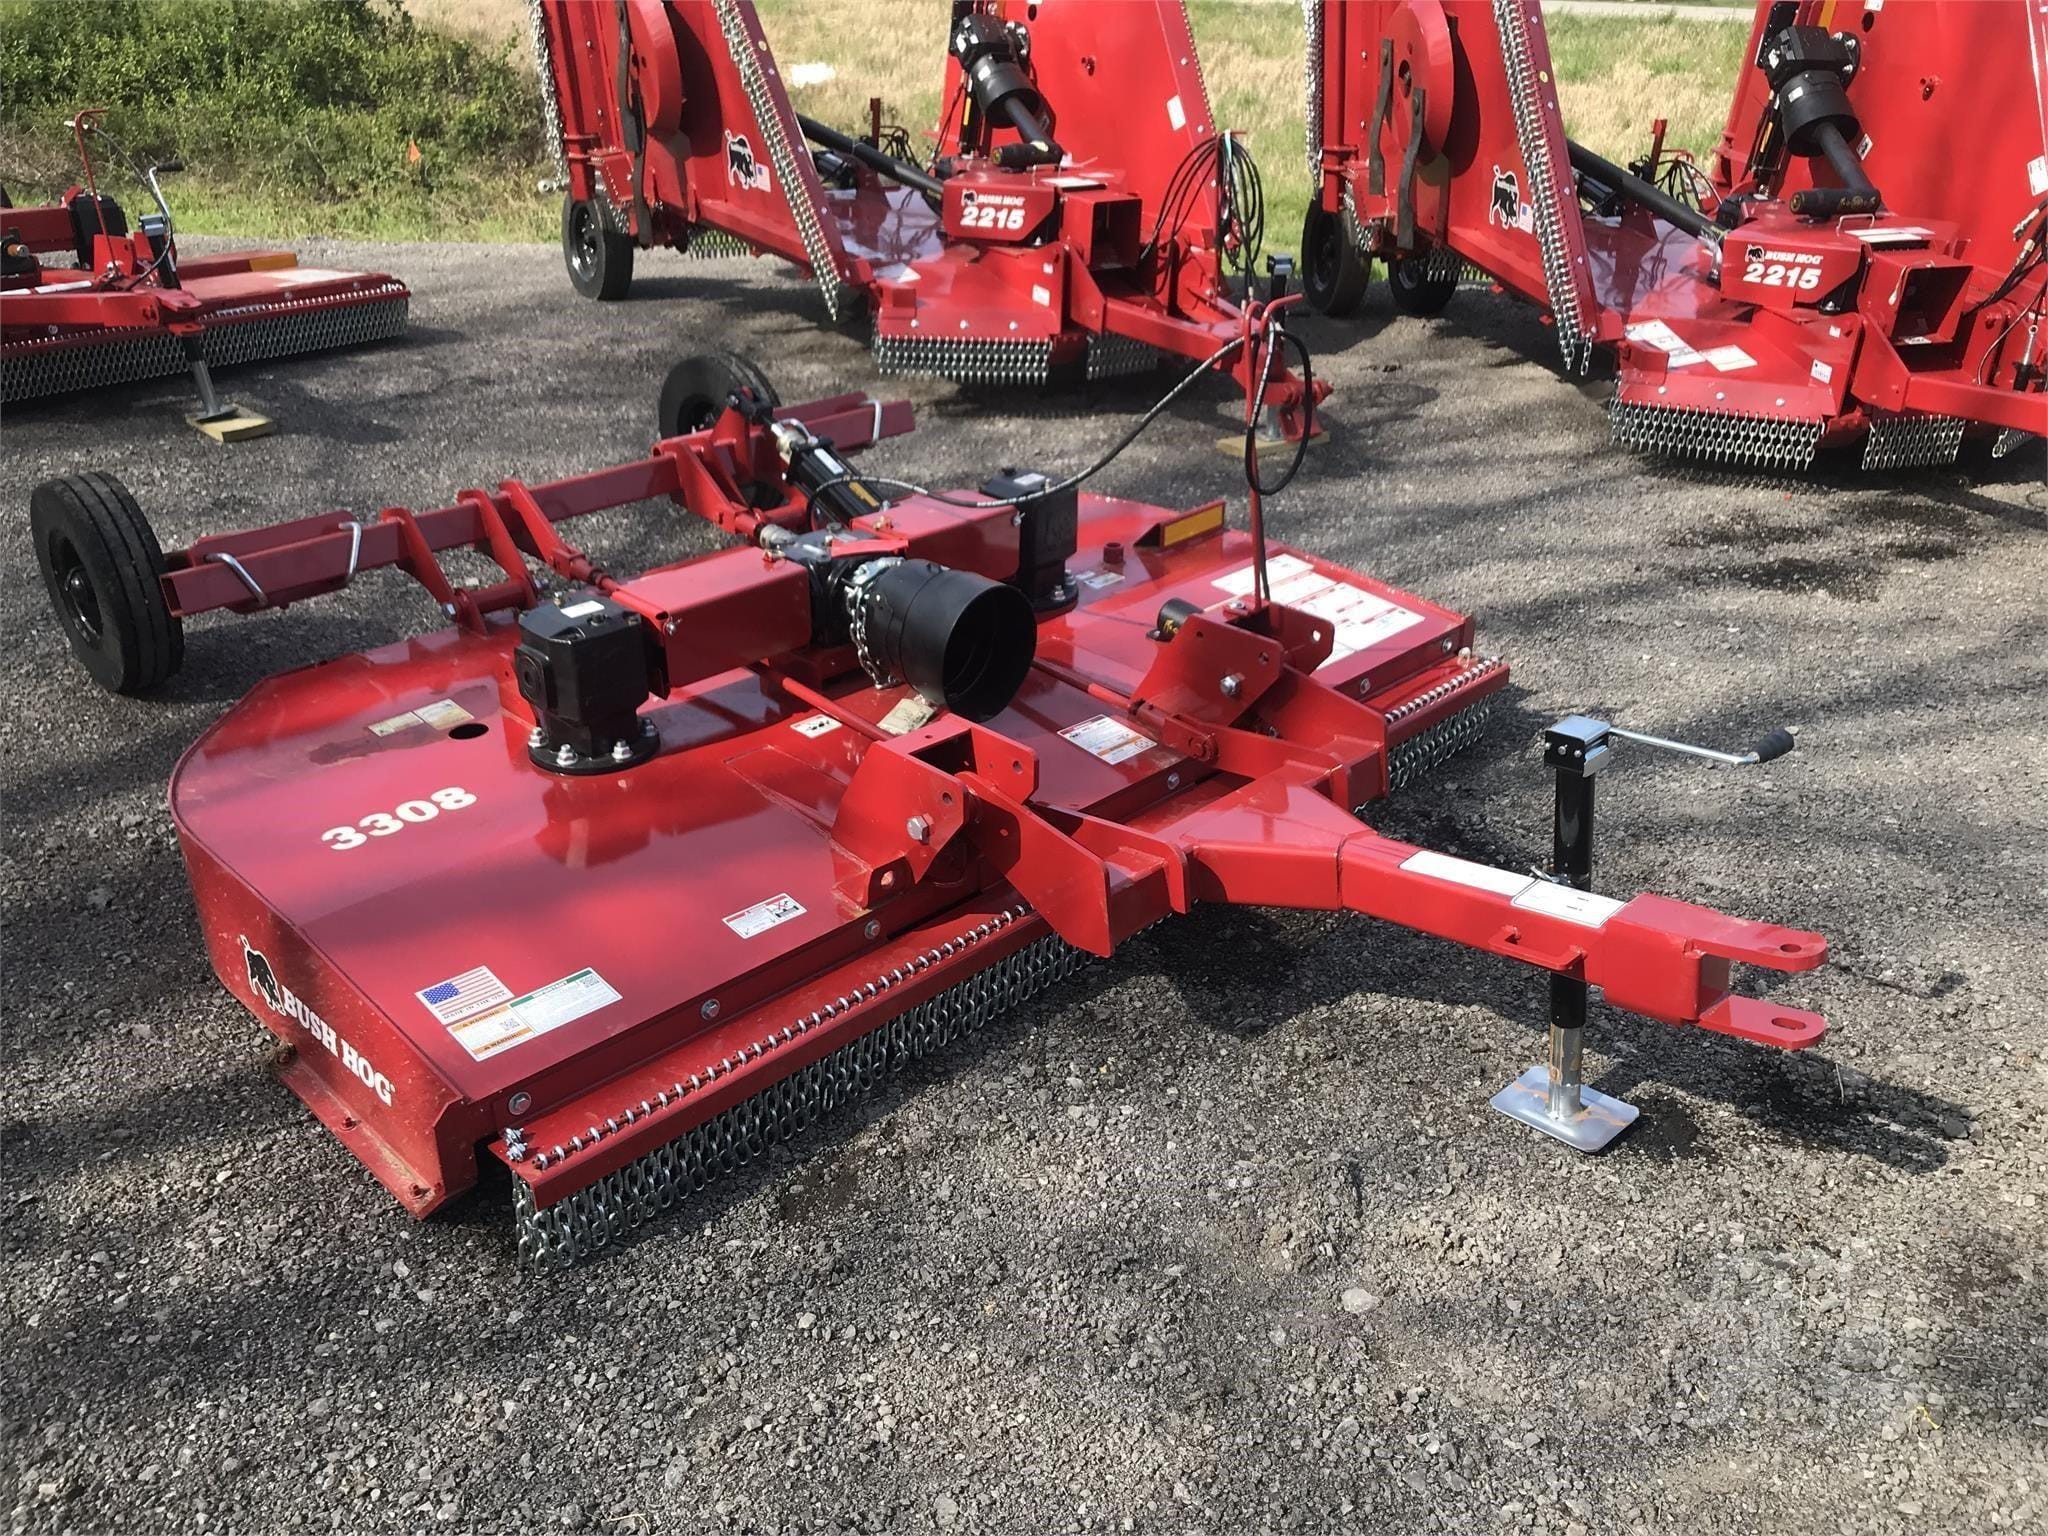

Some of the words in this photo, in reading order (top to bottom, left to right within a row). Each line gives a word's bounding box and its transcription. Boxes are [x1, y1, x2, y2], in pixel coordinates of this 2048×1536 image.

[960, 206, 1025, 230] 2215
[1765, 251, 1796, 262] BUSH
[1743, 263, 1822, 290] 2215
[321, 787, 477, 850] 3308
[282, 985, 338, 1057] BUSH
[341, 1038, 392, 1107] HOG
